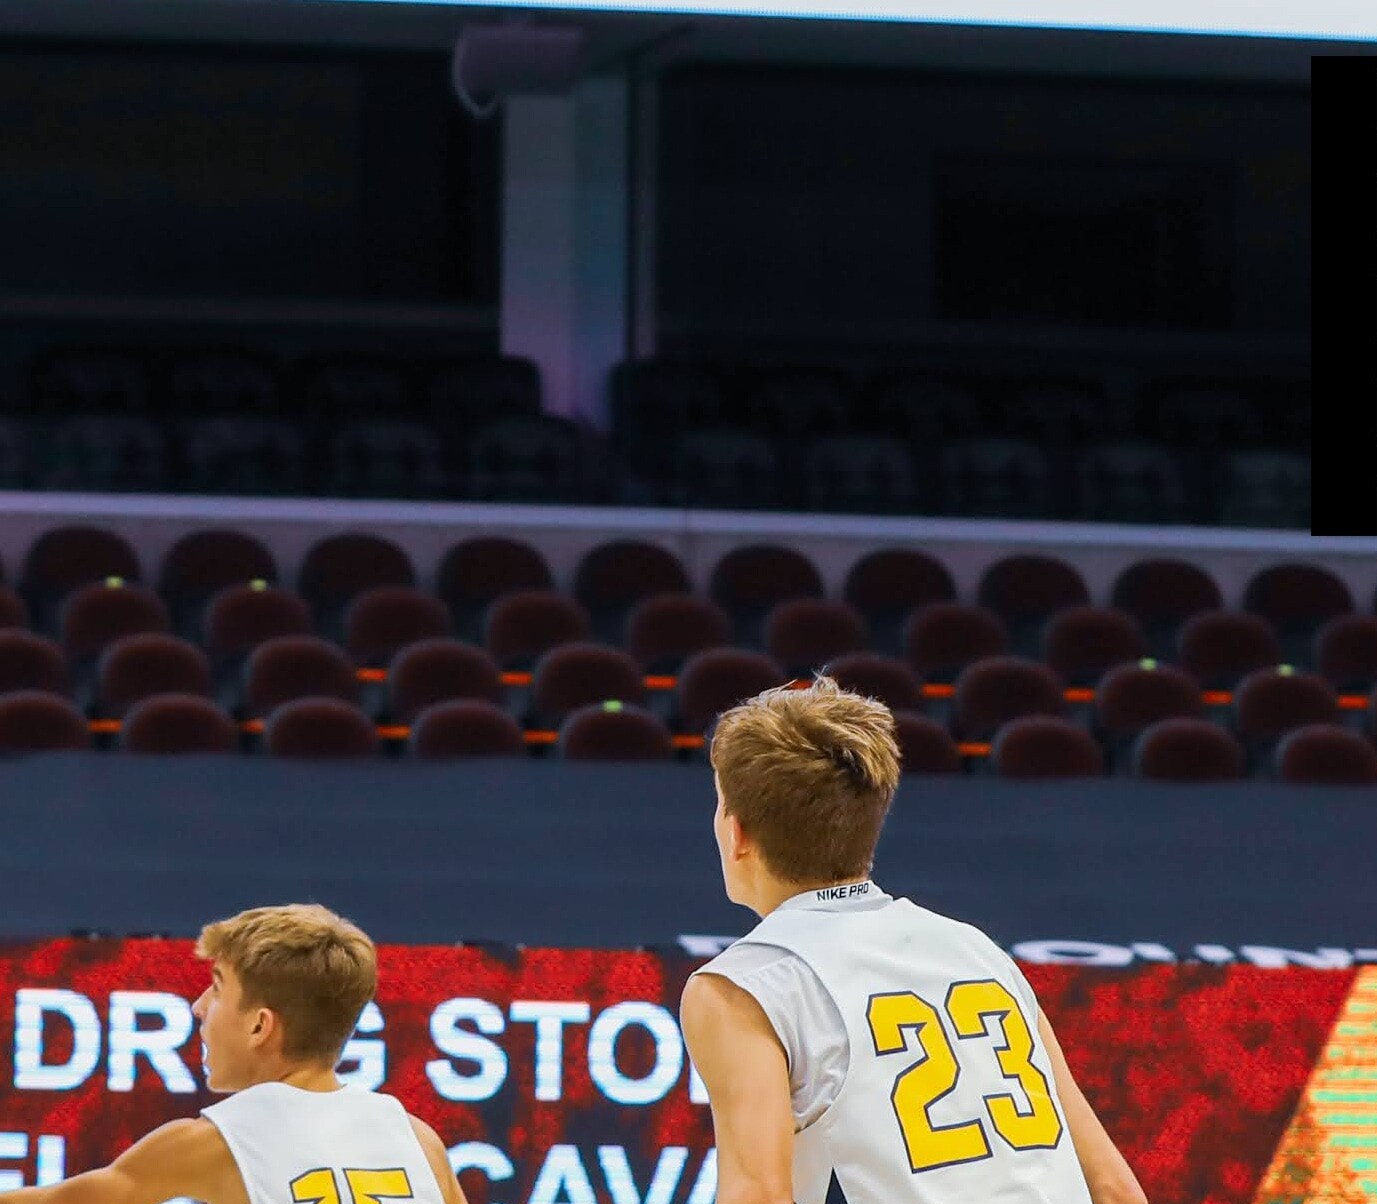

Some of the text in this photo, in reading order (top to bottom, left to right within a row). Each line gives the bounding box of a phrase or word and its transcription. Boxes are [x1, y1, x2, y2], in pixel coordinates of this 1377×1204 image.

[817, 882, 869, 902] NIKE PRO
[425, 997, 712, 1105] STO
[867, 979, 1064, 1174] 23
